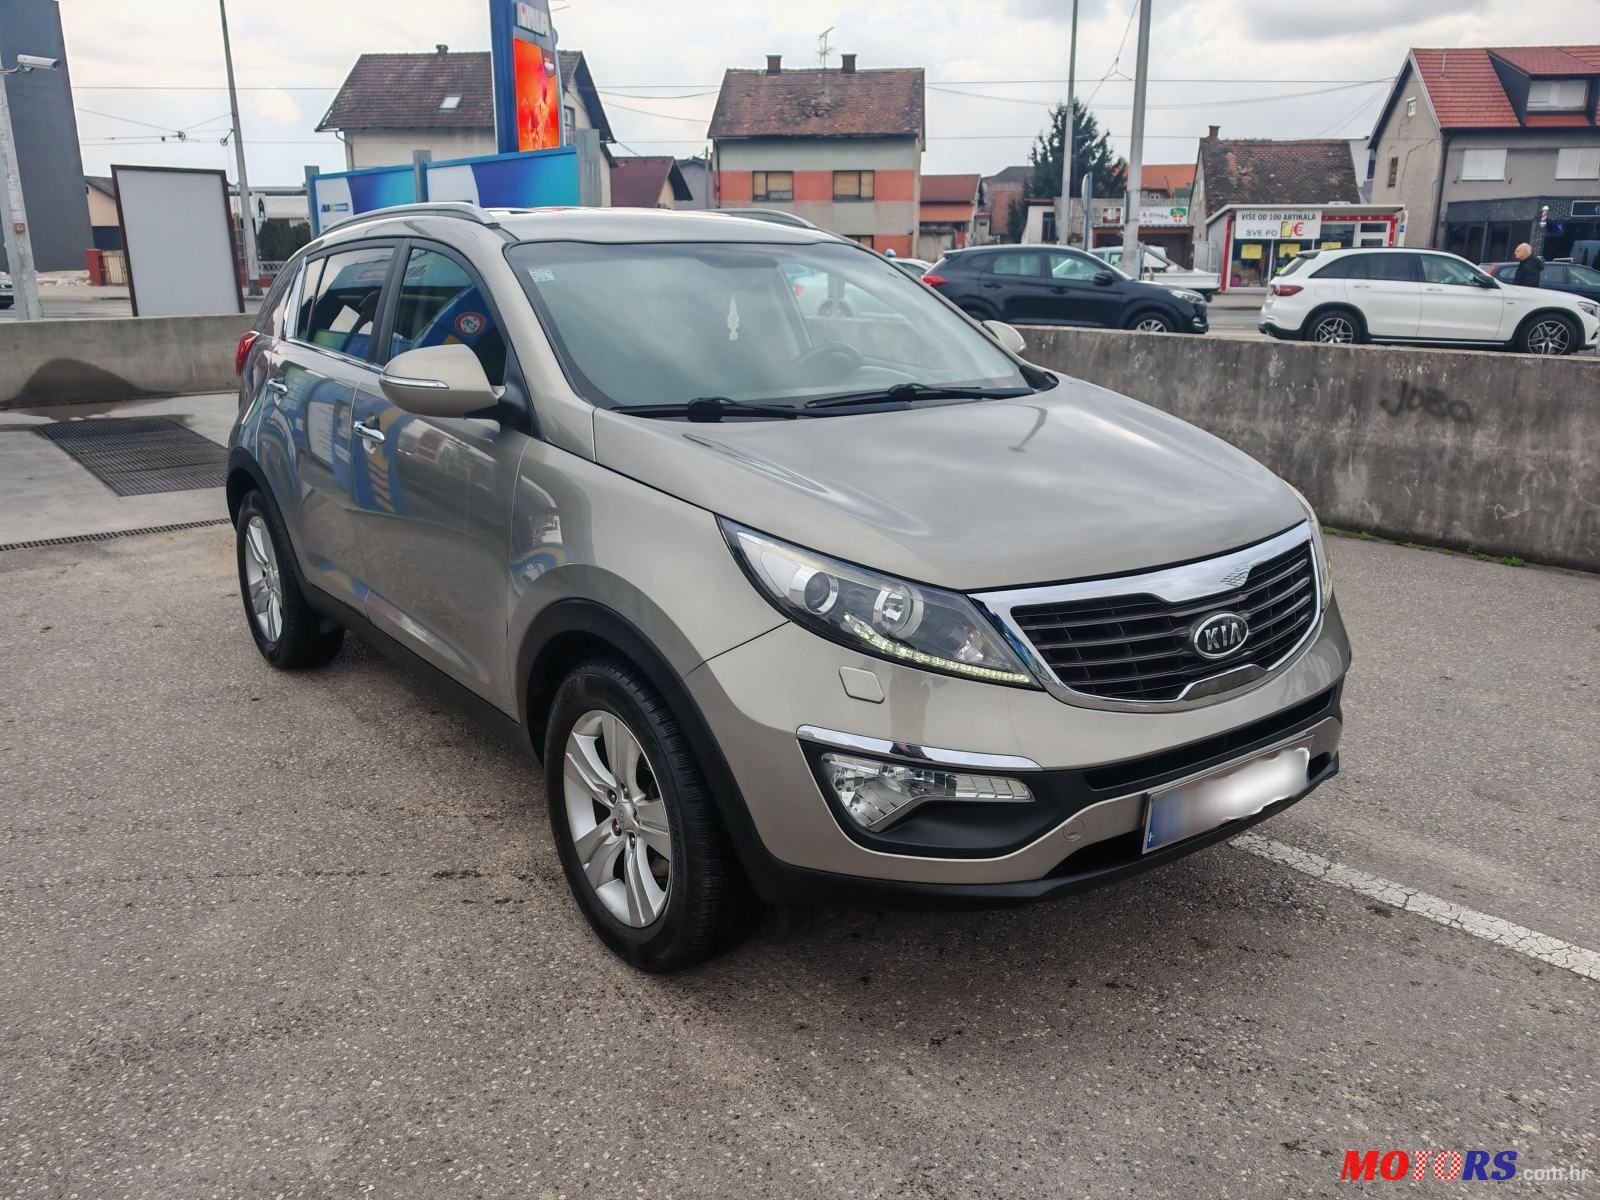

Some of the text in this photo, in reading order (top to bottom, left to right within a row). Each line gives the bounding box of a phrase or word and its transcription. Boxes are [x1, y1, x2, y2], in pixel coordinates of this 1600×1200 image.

[1241, 212, 1316, 221] VIŠE OD 100 ARTIKALA
[1246, 229, 1264, 237] SVE
[1265, 229, 1278, 237] PO
[1204, 622, 1242, 651] KIA
